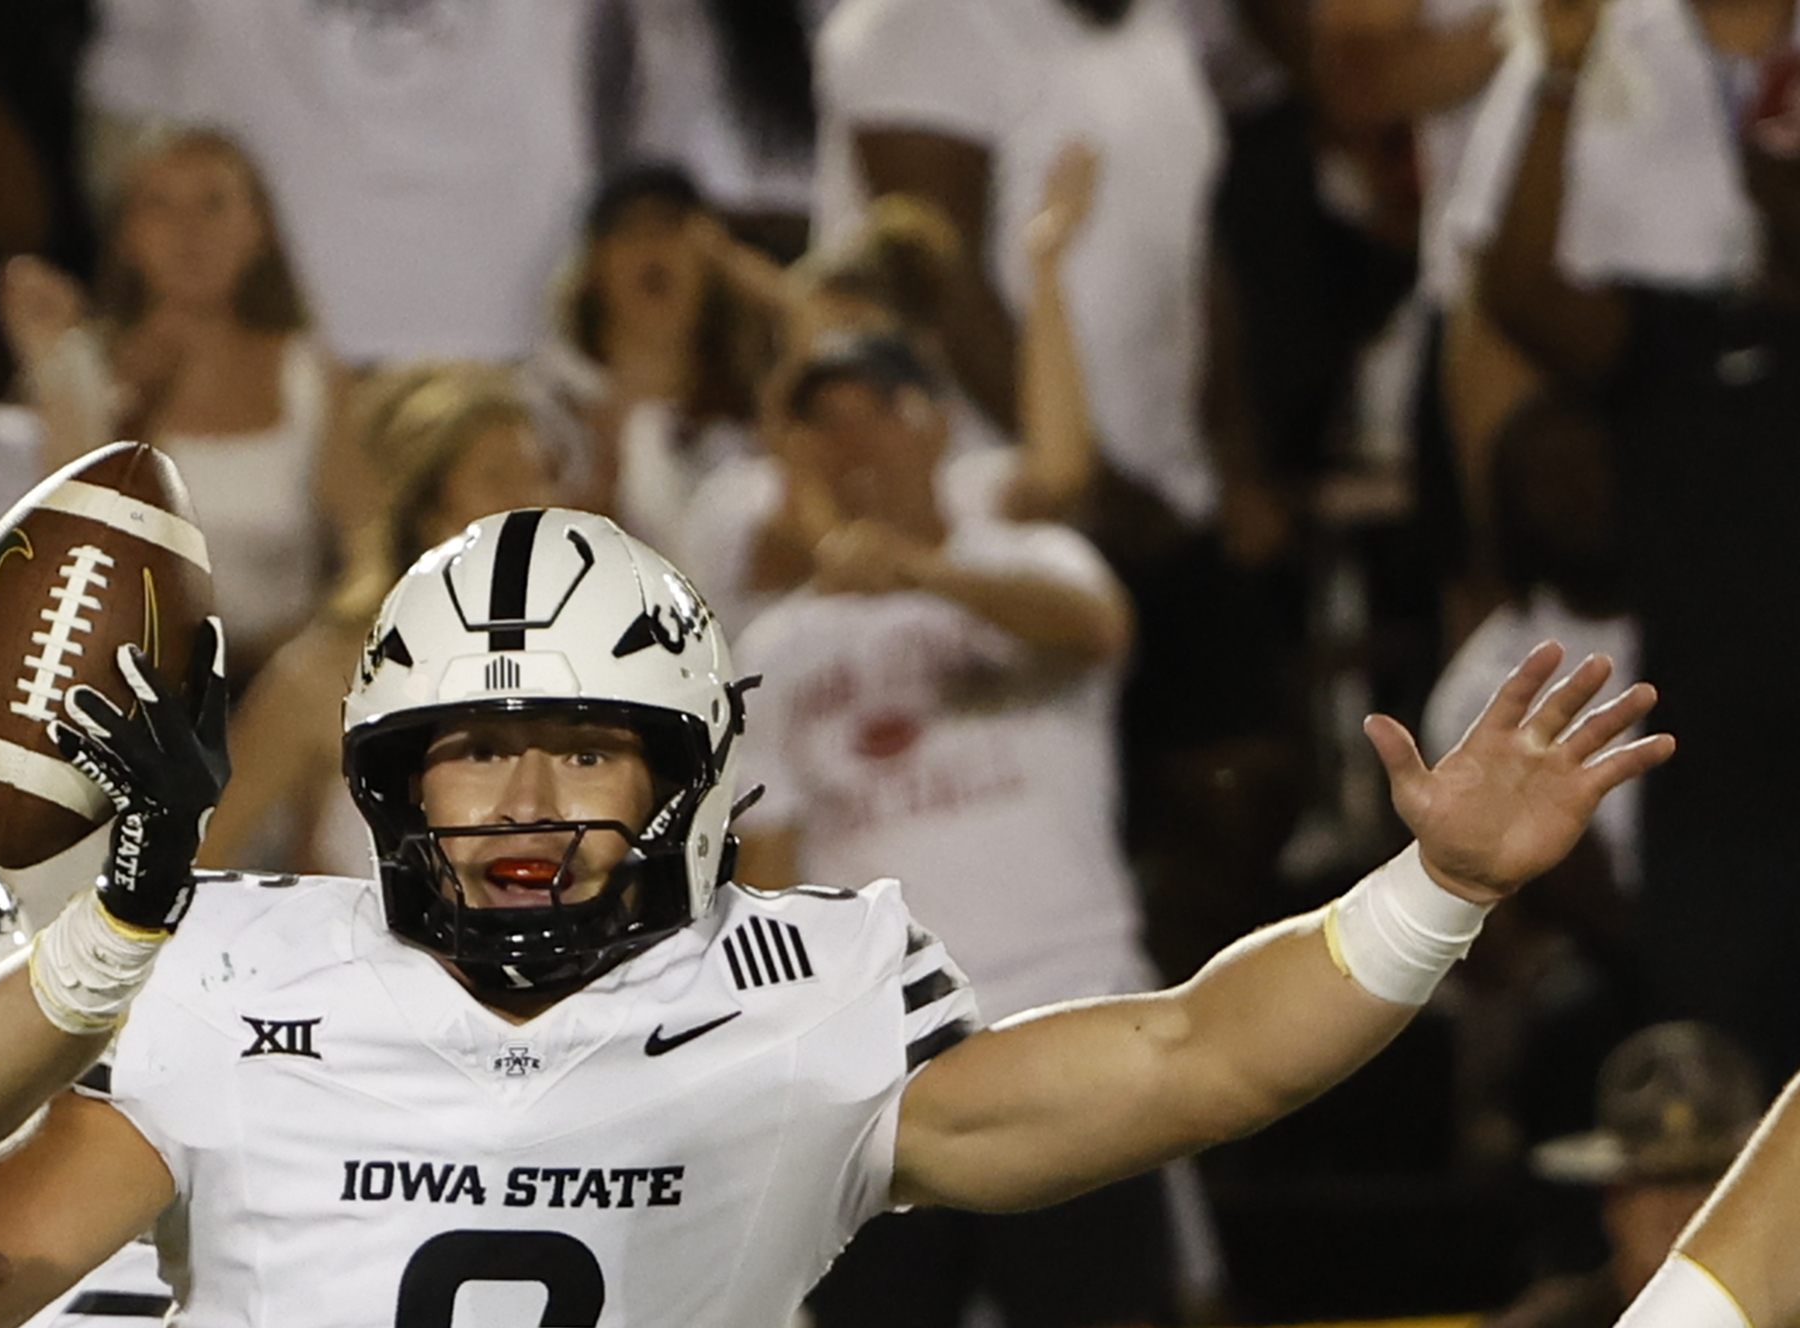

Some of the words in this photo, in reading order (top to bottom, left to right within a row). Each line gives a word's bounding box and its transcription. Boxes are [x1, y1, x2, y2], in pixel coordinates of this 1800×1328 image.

[240, 1015, 323, 1061] XII
[339, 1160, 486, 1205] IOWA
[503, 1165, 685, 1210] STATE
